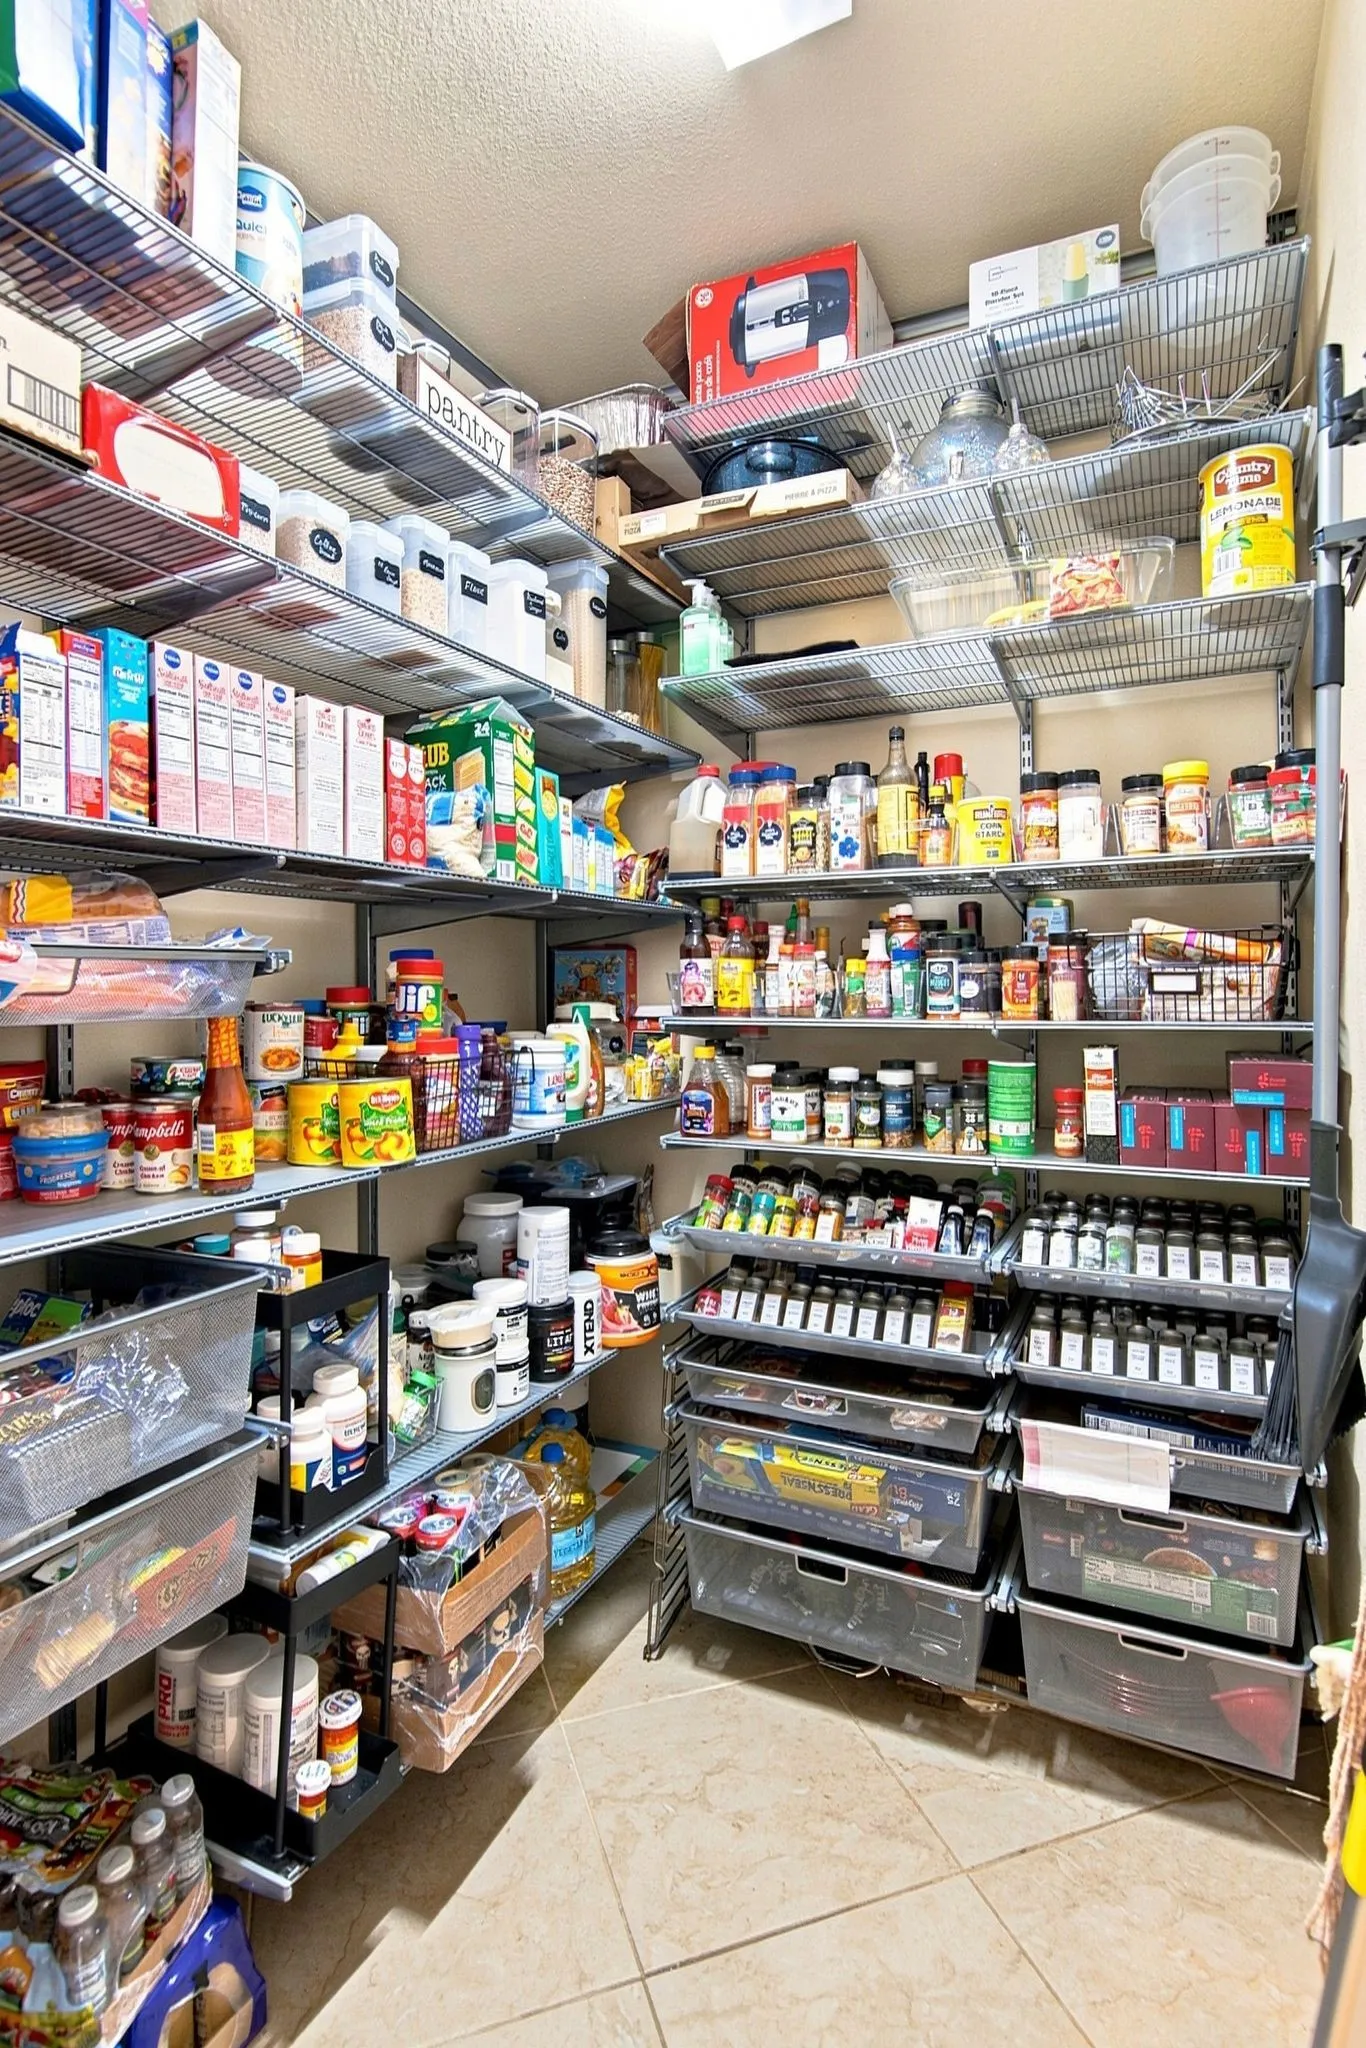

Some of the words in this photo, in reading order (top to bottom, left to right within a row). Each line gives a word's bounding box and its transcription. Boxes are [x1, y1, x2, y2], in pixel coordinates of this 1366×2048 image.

[425, 381, 507, 468] pantry
[1209, 496, 1282, 522] LEMONADE
[395, 984, 436, 1013] Jif
[583, 1298, 595, 1357] XTEND
[157, 1672, 173, 1721] PRO
